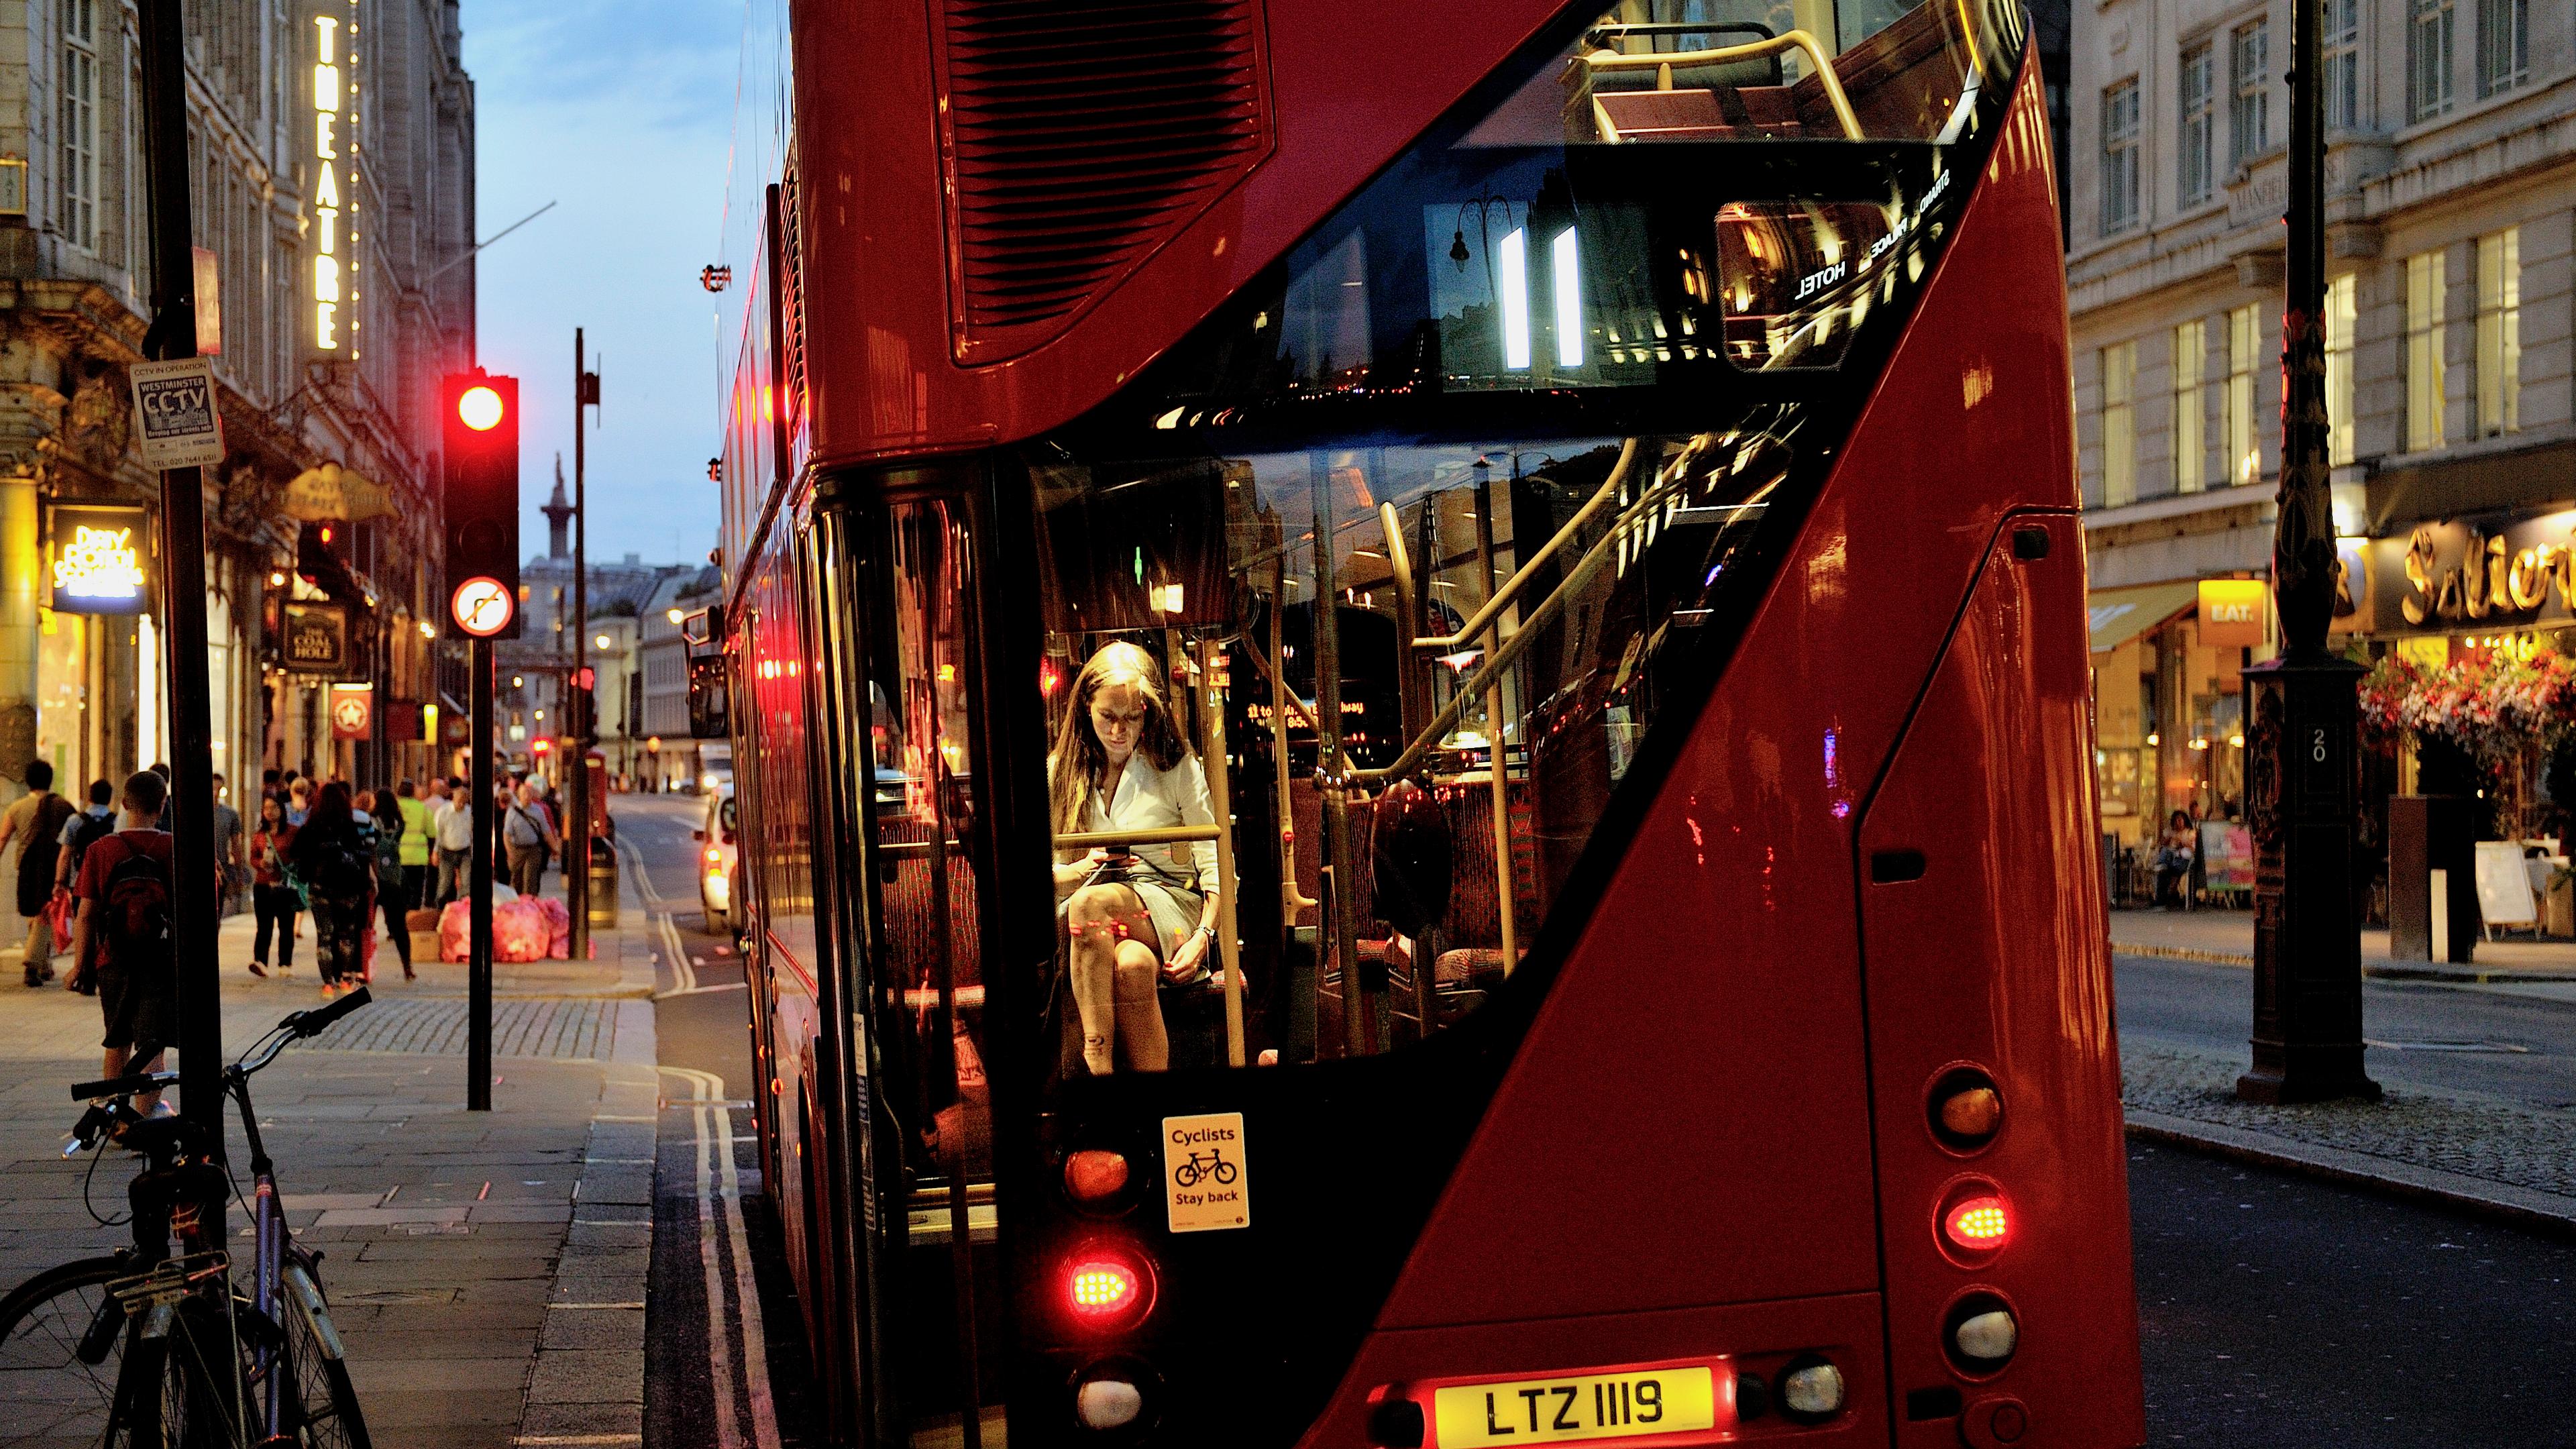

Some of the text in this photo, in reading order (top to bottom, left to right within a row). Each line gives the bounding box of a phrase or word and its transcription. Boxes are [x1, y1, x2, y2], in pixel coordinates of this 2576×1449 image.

[314, 15, 339, 350] THEATRE
[134, 362, 207, 377] CCTV IN OPERATION
[140, 377, 205, 392] WESTMINSTER
[143, 386, 205, 415] CCTV
[170, 457, 183, 466] 020
[184, 455, 201, 464] 7641
[293, 635, 329, 648] COAL
[294, 645, 333, 659] HOLE
[1260, 706, 1273, 718] to
[1171, 1128, 1236, 1146] Cyclists
[1175, 1189, 1238, 1206] Stay back
[1485, 1379, 1664, 1436] LTZ 1119
